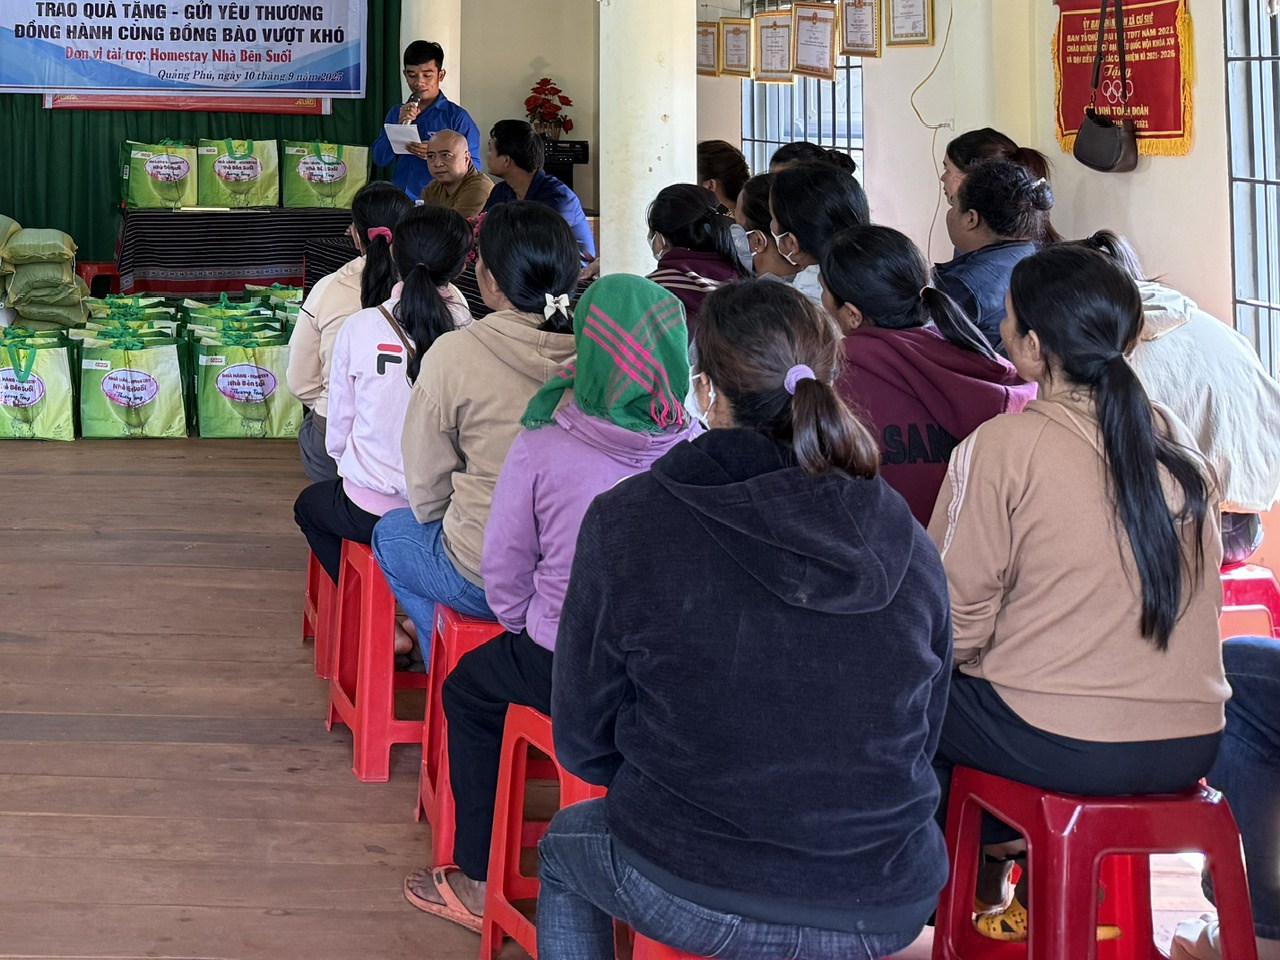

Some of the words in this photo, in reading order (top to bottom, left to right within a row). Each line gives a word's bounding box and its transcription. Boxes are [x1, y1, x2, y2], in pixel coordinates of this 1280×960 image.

[35, 1, 78, 17] TRAO
[83, 1, 117, 19] QUÀ
[122, 1, 167, 21] TẶNG
[184, 0, 213, 20] GỬI
[218, 2, 250, 20] YÊU
[255, 4, 323, 21] THƯƠNG
[14, 19, 61, 39] ĐỒNG
[66, 22, 113, 40] HÀNH
[118, 23, 165, 41] CÙNG
[169, 22, 217, 42] ĐỒNG
[222, 25, 257, 43] BÀO
[262, 28, 305, 46] VƯỢT
[310, 26, 345, 44] KHÓ
[1067, 34, 1080, 42] BAN
[1087, 32, 1099, 41] CHỨ
[1158, 26, 1174, 35] 2021
[65, 46, 89, 59] Đơn
[92, 47, 103, 63] vị
[106, 47, 122, 60] tài
[125, 50, 147, 63] trợ:
[150, 48, 208, 64] Homestay
[212, 49, 236, 62] Nhà
[240, 49, 262, 62] Bên
[266, 49, 292, 63] Suối
[157, 69, 190, 81] Quảng
[192, 70, 215, 81] Phú,
[217, 71, 242, 81] ngày
[244, 71, 255, 81] 10
[257, 71, 285, 81] tháng
[288, 72, 294, 81] 9
[296, 72, 319, 81] năm
[320, 72, 344, 81] 2025
[1104, 64, 1132, 79] Tặg
